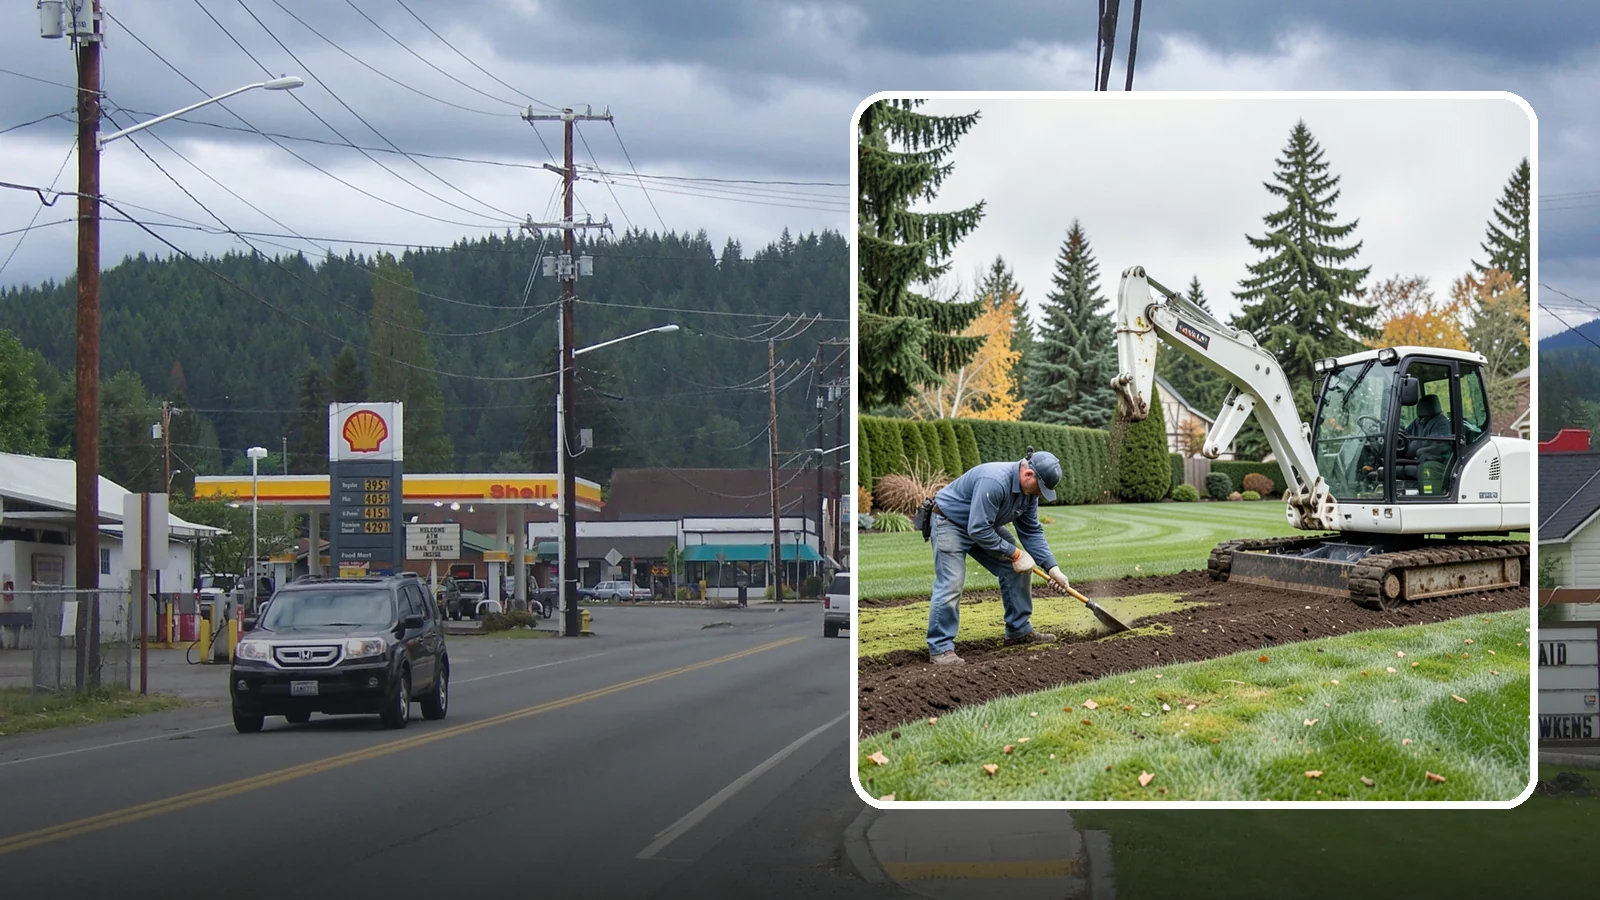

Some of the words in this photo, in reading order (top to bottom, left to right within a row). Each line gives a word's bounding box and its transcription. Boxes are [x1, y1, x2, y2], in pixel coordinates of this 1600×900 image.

[366, 480, 383, 490] 395
[490, 484, 547, 499] Shell
[366, 494, 383, 504] 405
[365, 508, 383, 518] 415
[366, 522, 383, 533] 429
[1539, 643, 1567, 665] AID
[1538, 715, 1592, 739] WKENS
